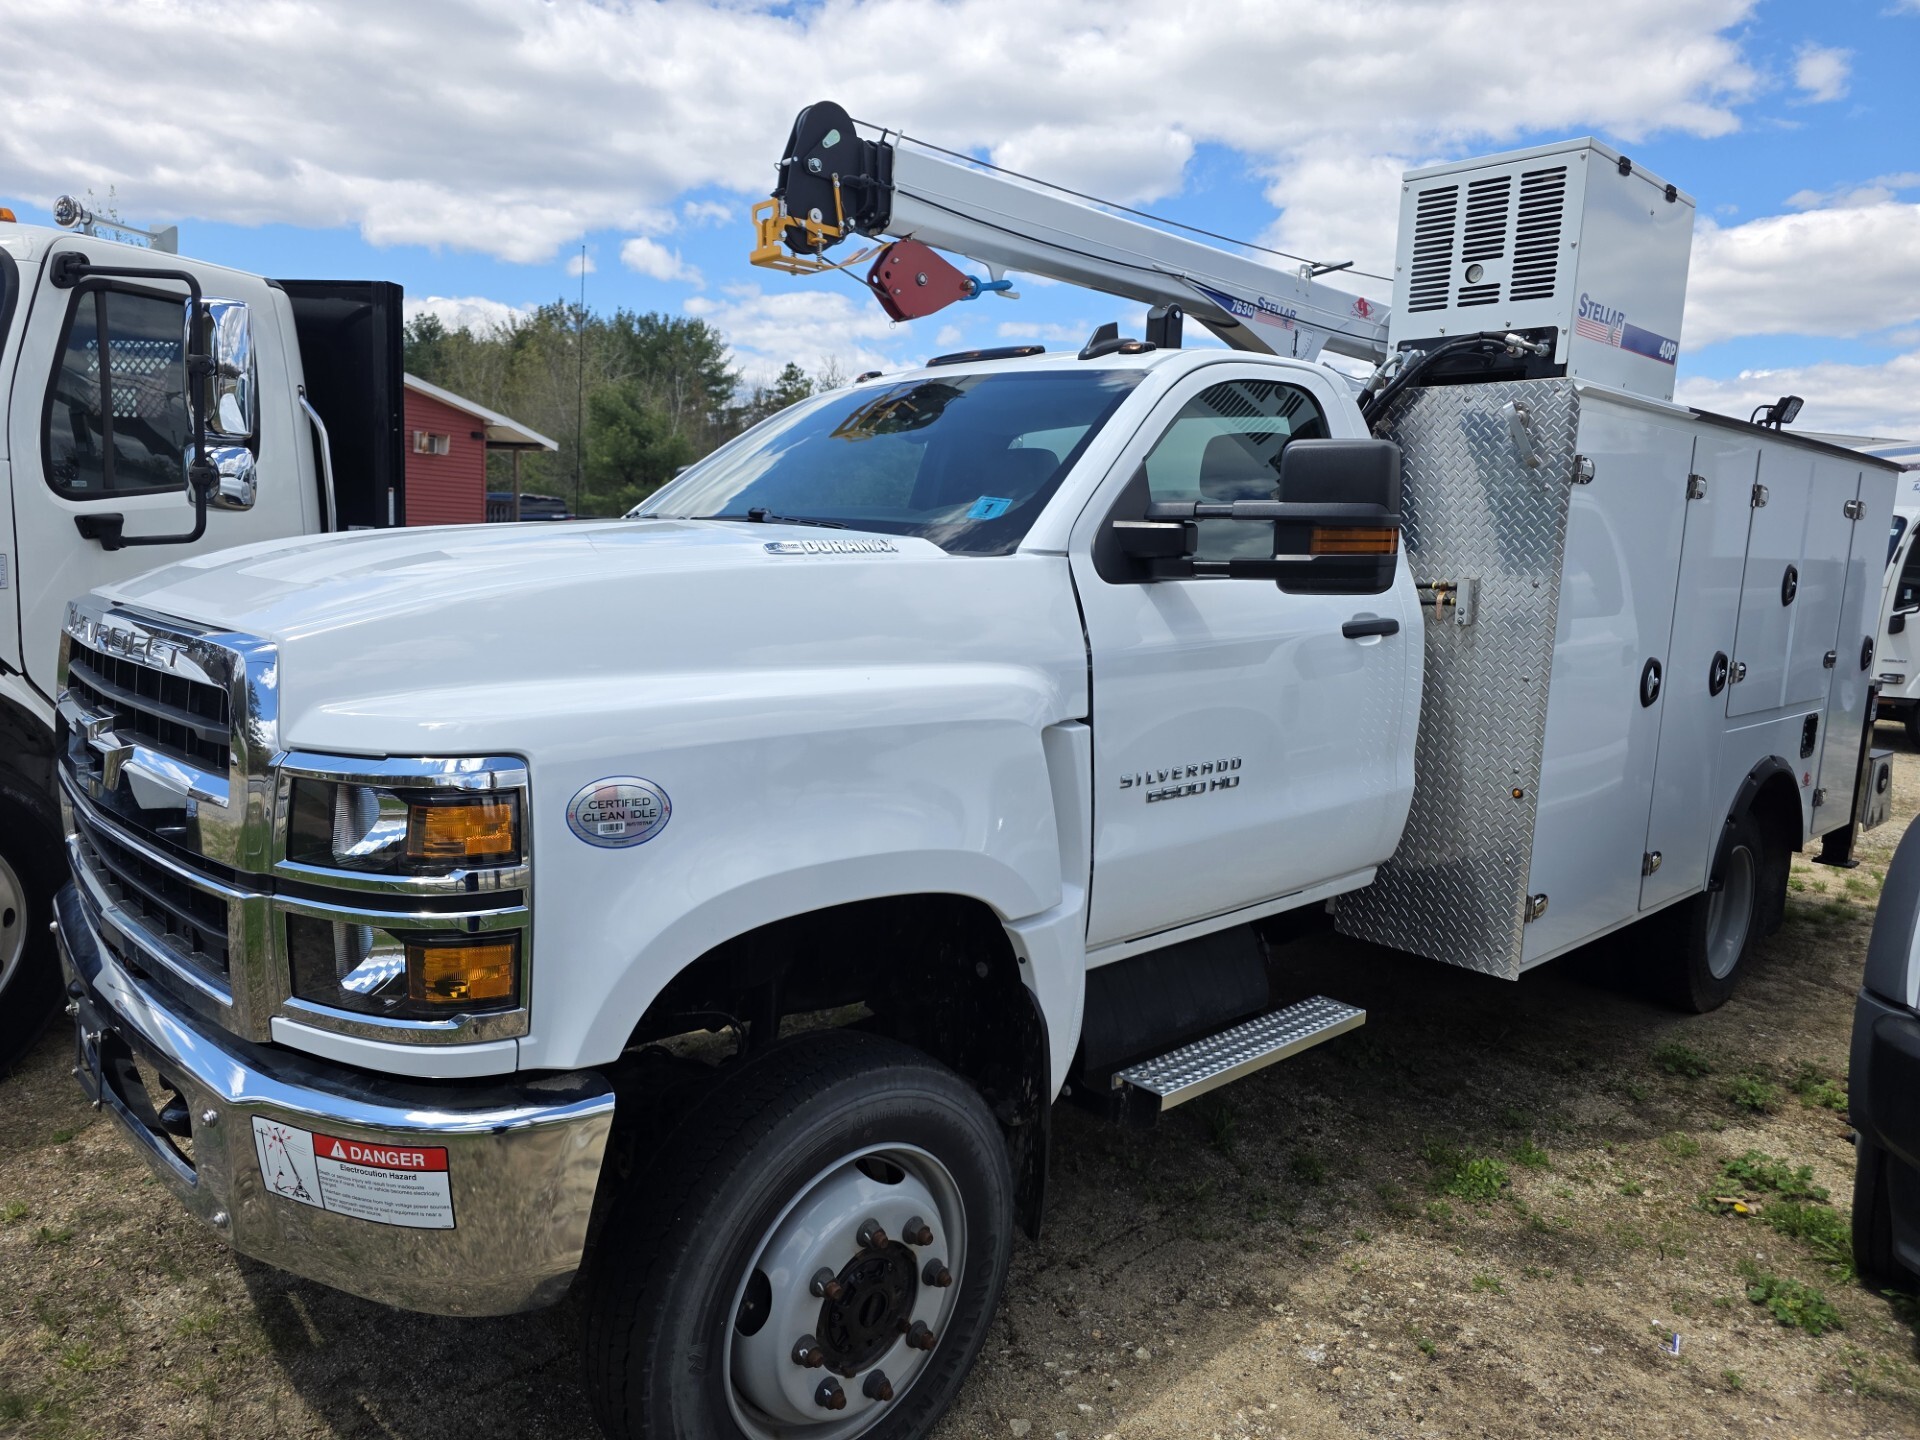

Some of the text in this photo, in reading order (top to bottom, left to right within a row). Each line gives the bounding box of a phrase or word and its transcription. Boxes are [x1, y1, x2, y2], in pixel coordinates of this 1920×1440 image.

[1231, 299, 1254, 317] 7630
[1257, 296, 1297, 320] STELLAR
[1578, 292, 1625, 328] STELLAR
[1659, 340, 1677, 361] 40P
[983, 503, 994, 514] 1
[801, 539, 899, 554] DURAMAX
[67, 600, 189, 669] CHEVROLET
[1120, 757, 1242, 789] SILVERADO
[588, 797, 651, 810] CERTIFIED
[582, 808, 657, 822] CLEAN IDLE
[350, 1146, 425, 1167] DANGER
[340, 1163, 417, 1181] Electrocution Hazard
